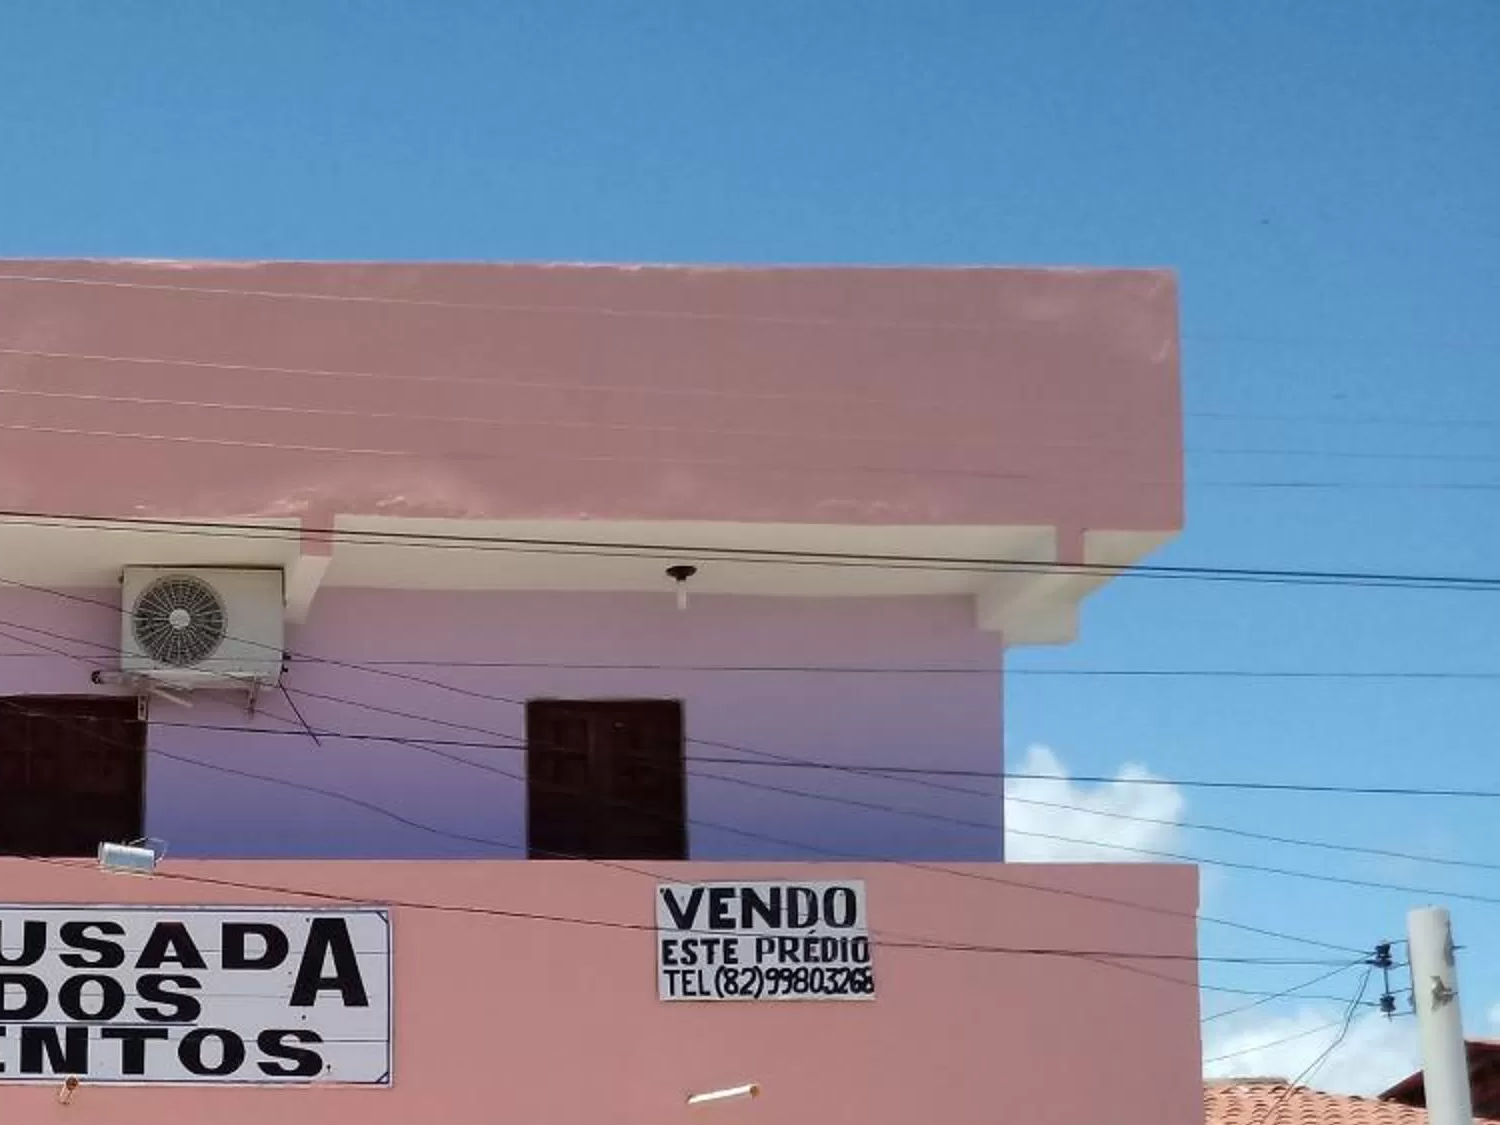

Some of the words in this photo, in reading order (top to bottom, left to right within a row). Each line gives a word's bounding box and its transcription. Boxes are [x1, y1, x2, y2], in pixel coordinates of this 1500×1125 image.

[663, 886, 857, 930] VENDO
[661, 938, 739, 965] ESTE
[755, 929, 870, 964] PRÉDIO
